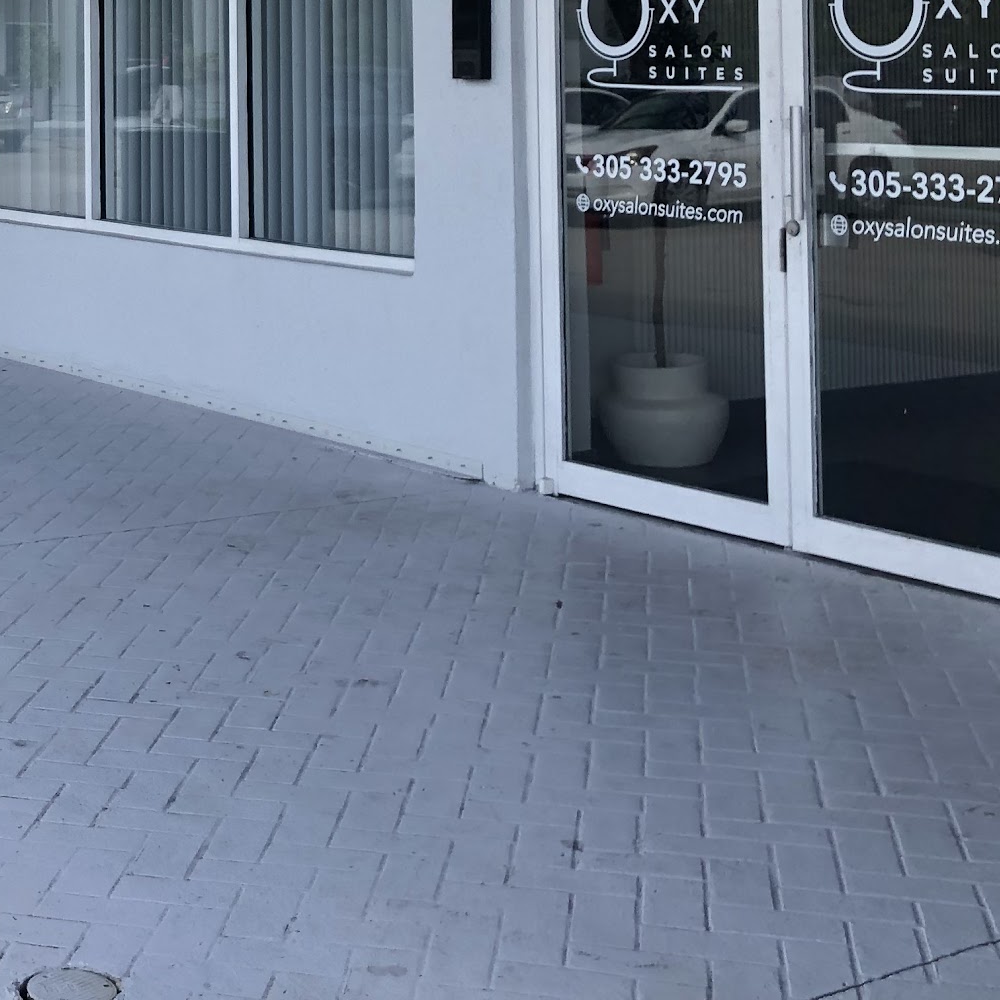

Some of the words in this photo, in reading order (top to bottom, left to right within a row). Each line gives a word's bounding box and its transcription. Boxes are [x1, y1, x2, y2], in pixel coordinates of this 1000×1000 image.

[648, 44, 732, 59] SALON
[648, 66, 744, 81] SUITES
[851, 168, 1000, 204] 305-333-2
[593, 194, 744, 225] oxysalonsuites.com
